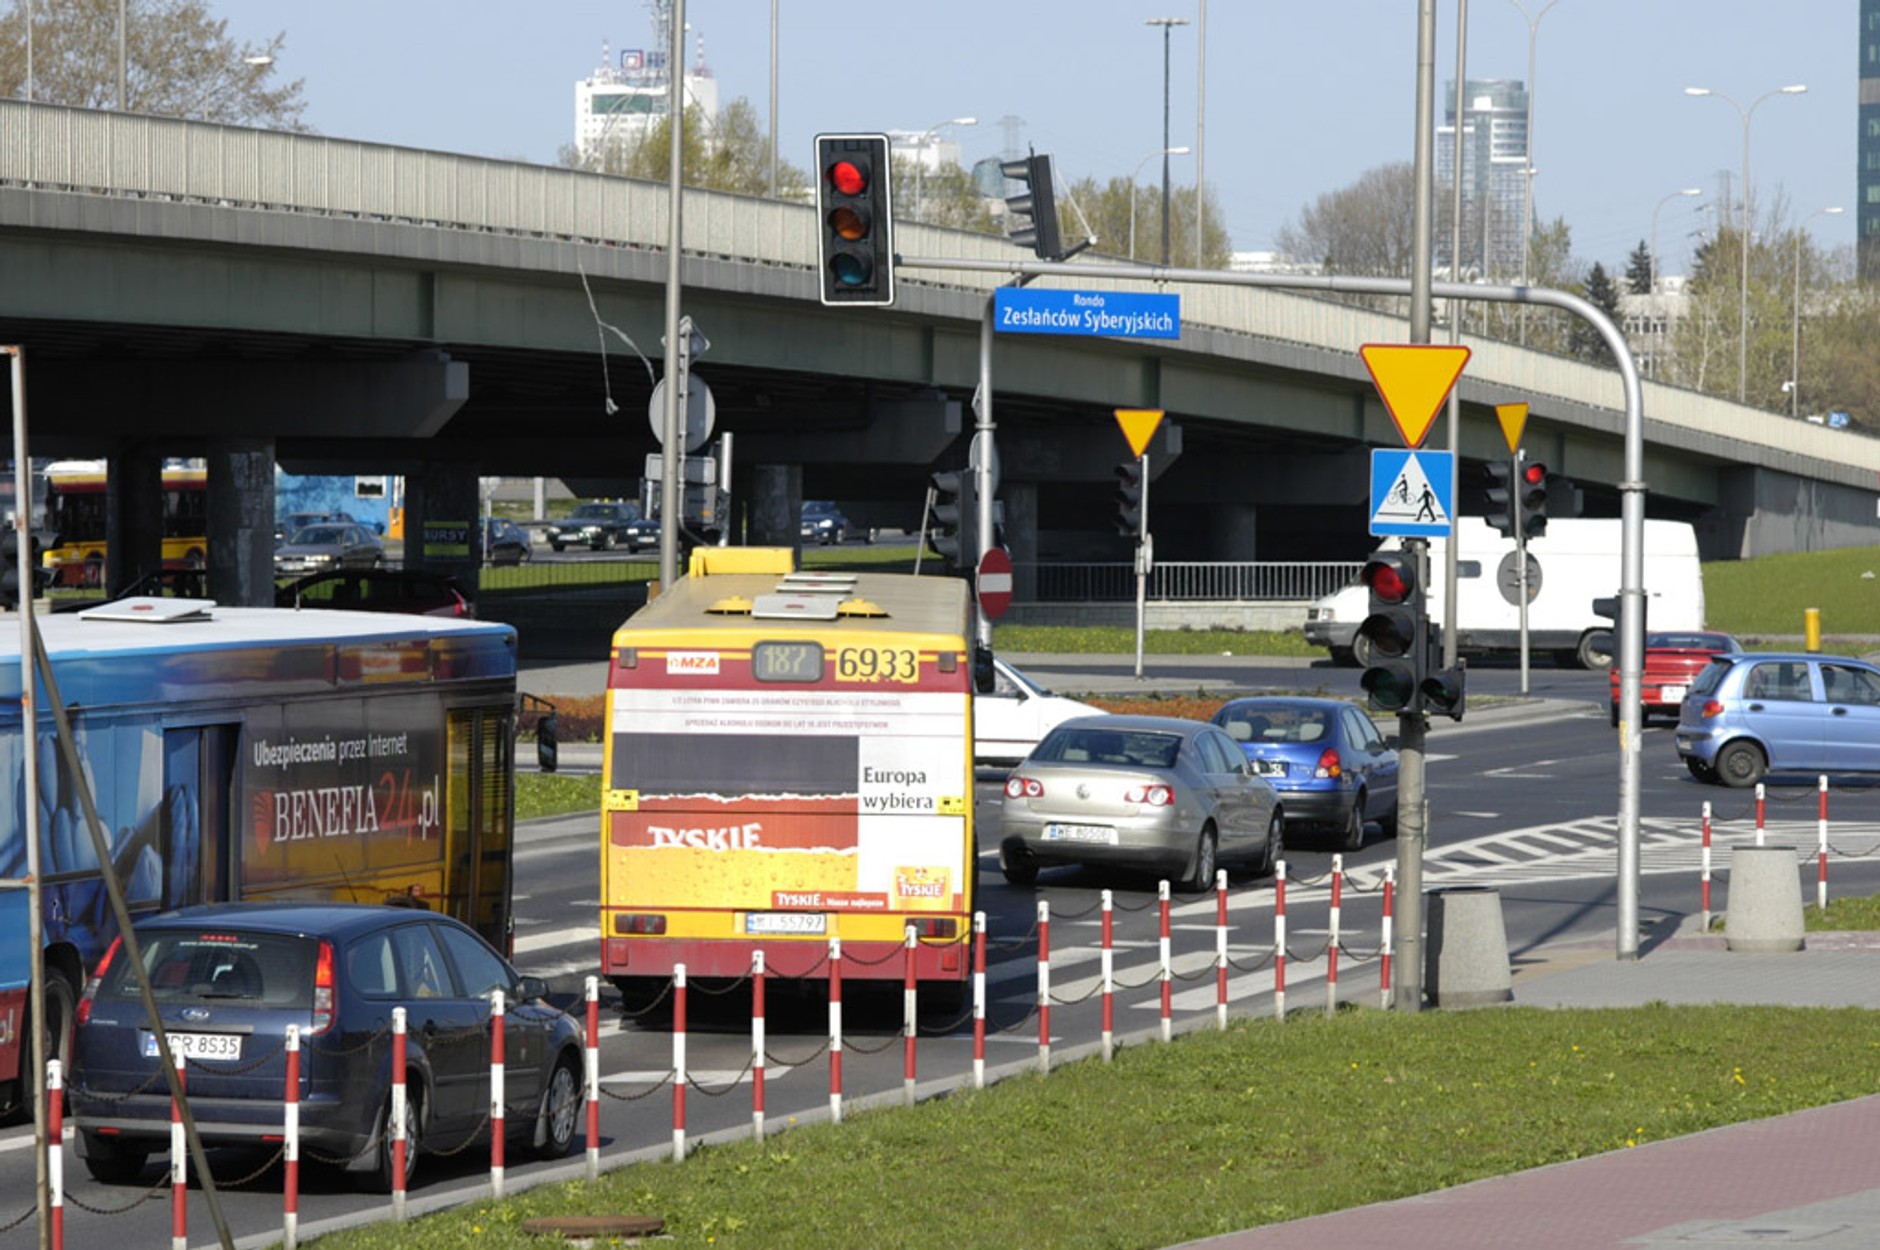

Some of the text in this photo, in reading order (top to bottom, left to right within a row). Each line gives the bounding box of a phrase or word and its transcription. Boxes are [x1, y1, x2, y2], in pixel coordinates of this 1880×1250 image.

[1073, 294, 1105, 307] Rondo
[1003, 307, 1173, 334] Zesłańców Syberyjskich
[680, 656, 717, 669] MZA
[763, 646, 806, 675] 187
[838, 647, 916, 679] 6933
[254, 732, 408, 771] Ubezpieczenia przez Internet
[863, 766, 927, 787] Europa
[863, 793, 933, 811] wybiera
[647, 822, 763, 849] TYSKIE
[901, 884, 941, 896] TYSKIE
[780, 916, 822, 930] 55797
[198, 1037, 238, 1055] 8S35
